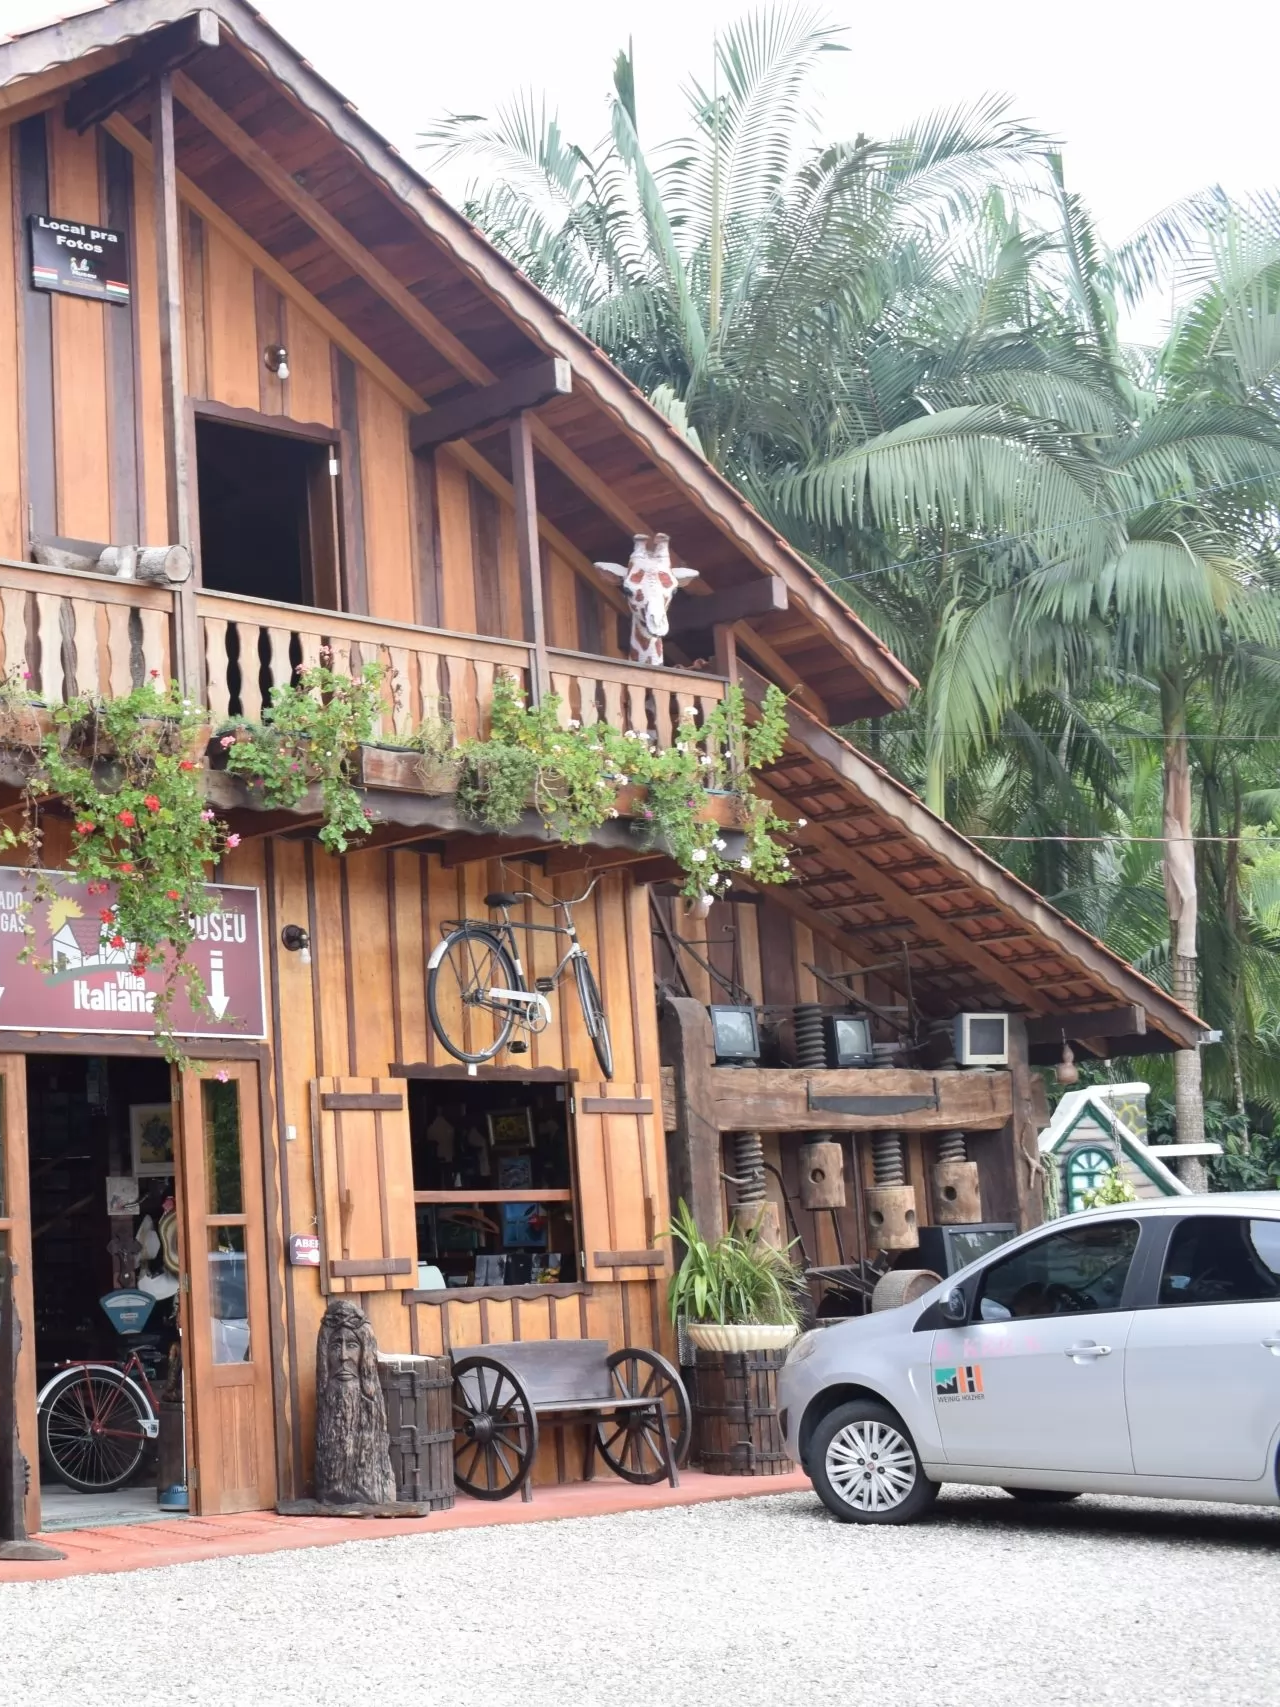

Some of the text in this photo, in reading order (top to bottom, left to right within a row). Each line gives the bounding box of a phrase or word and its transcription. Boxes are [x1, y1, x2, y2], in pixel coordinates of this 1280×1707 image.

[39, 217, 119, 243] Local pra
[56, 235, 104, 254] Fotos
[180, 910, 247, 943] USEU
[116, 971, 146, 991] Villa
[73, 980, 158, 1014] Italiana
